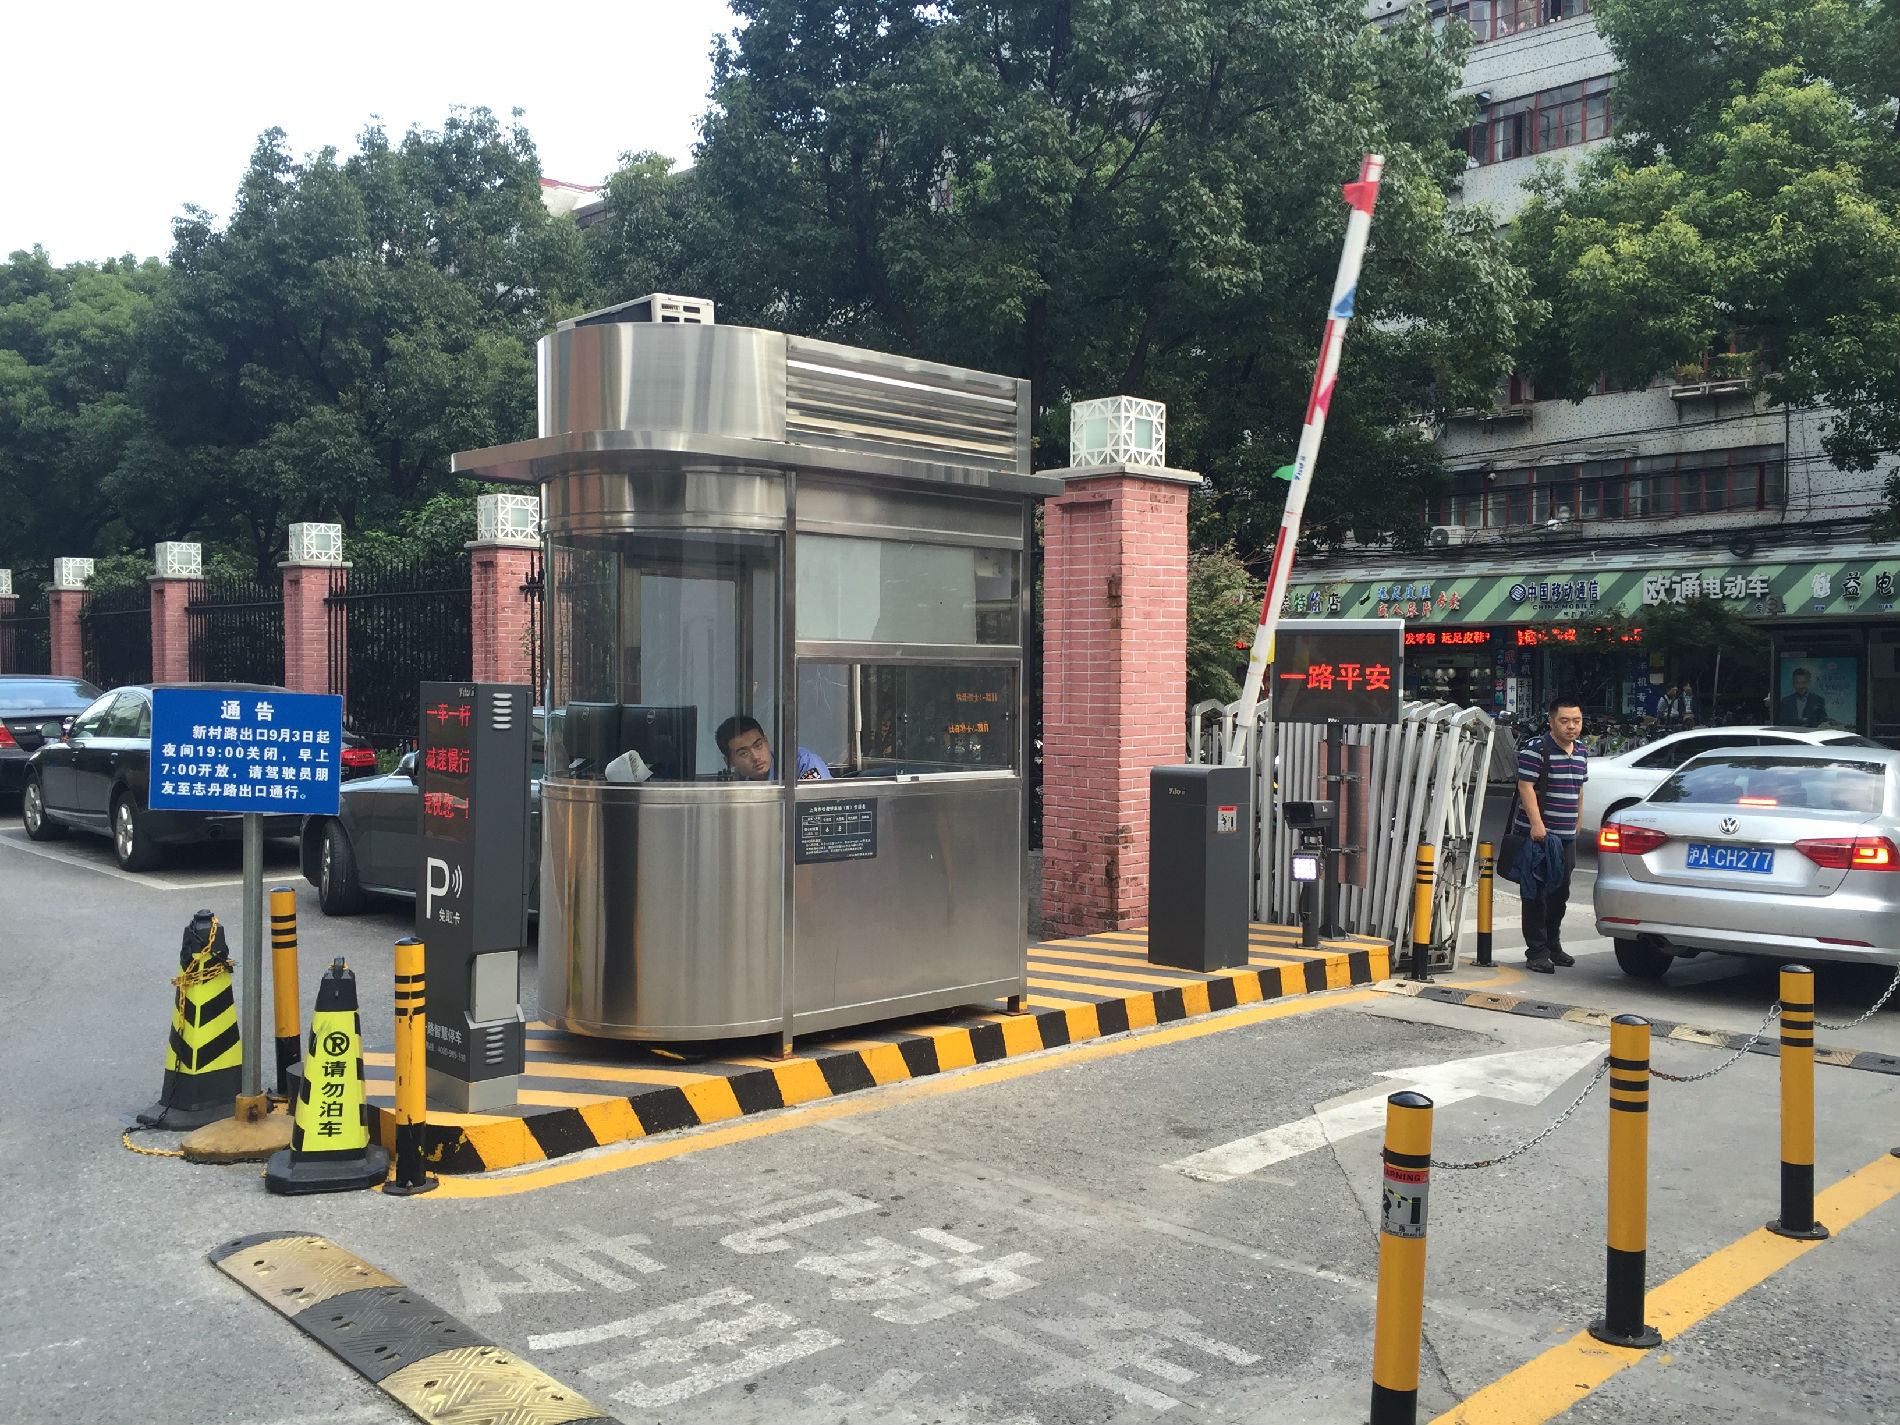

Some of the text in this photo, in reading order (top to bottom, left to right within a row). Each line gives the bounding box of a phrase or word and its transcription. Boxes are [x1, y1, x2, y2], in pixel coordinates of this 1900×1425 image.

[1377, 584, 1432, 601] 远足皮鞋
[1527, 581, 1600, 602] 中国移动通信
[1642, 573, 1769, 606] 欧通电动车
[1377, 601, 1433, 618] 成人尿片
[1436, 591, 1461, 611] 专卖
[1280, 664, 1391, 691] 一路平安
[426, 703, 471, 727] 一车一杆
[192, 725, 330, 745] 新村路出口9月3日起
[425, 746, 470, 774] 减速慢行
[161, 781, 307, 801] 友至志丹路出口通行。
[426, 856, 450, 919] P
[317, 1060, 347, 1137] 请勿泊车
